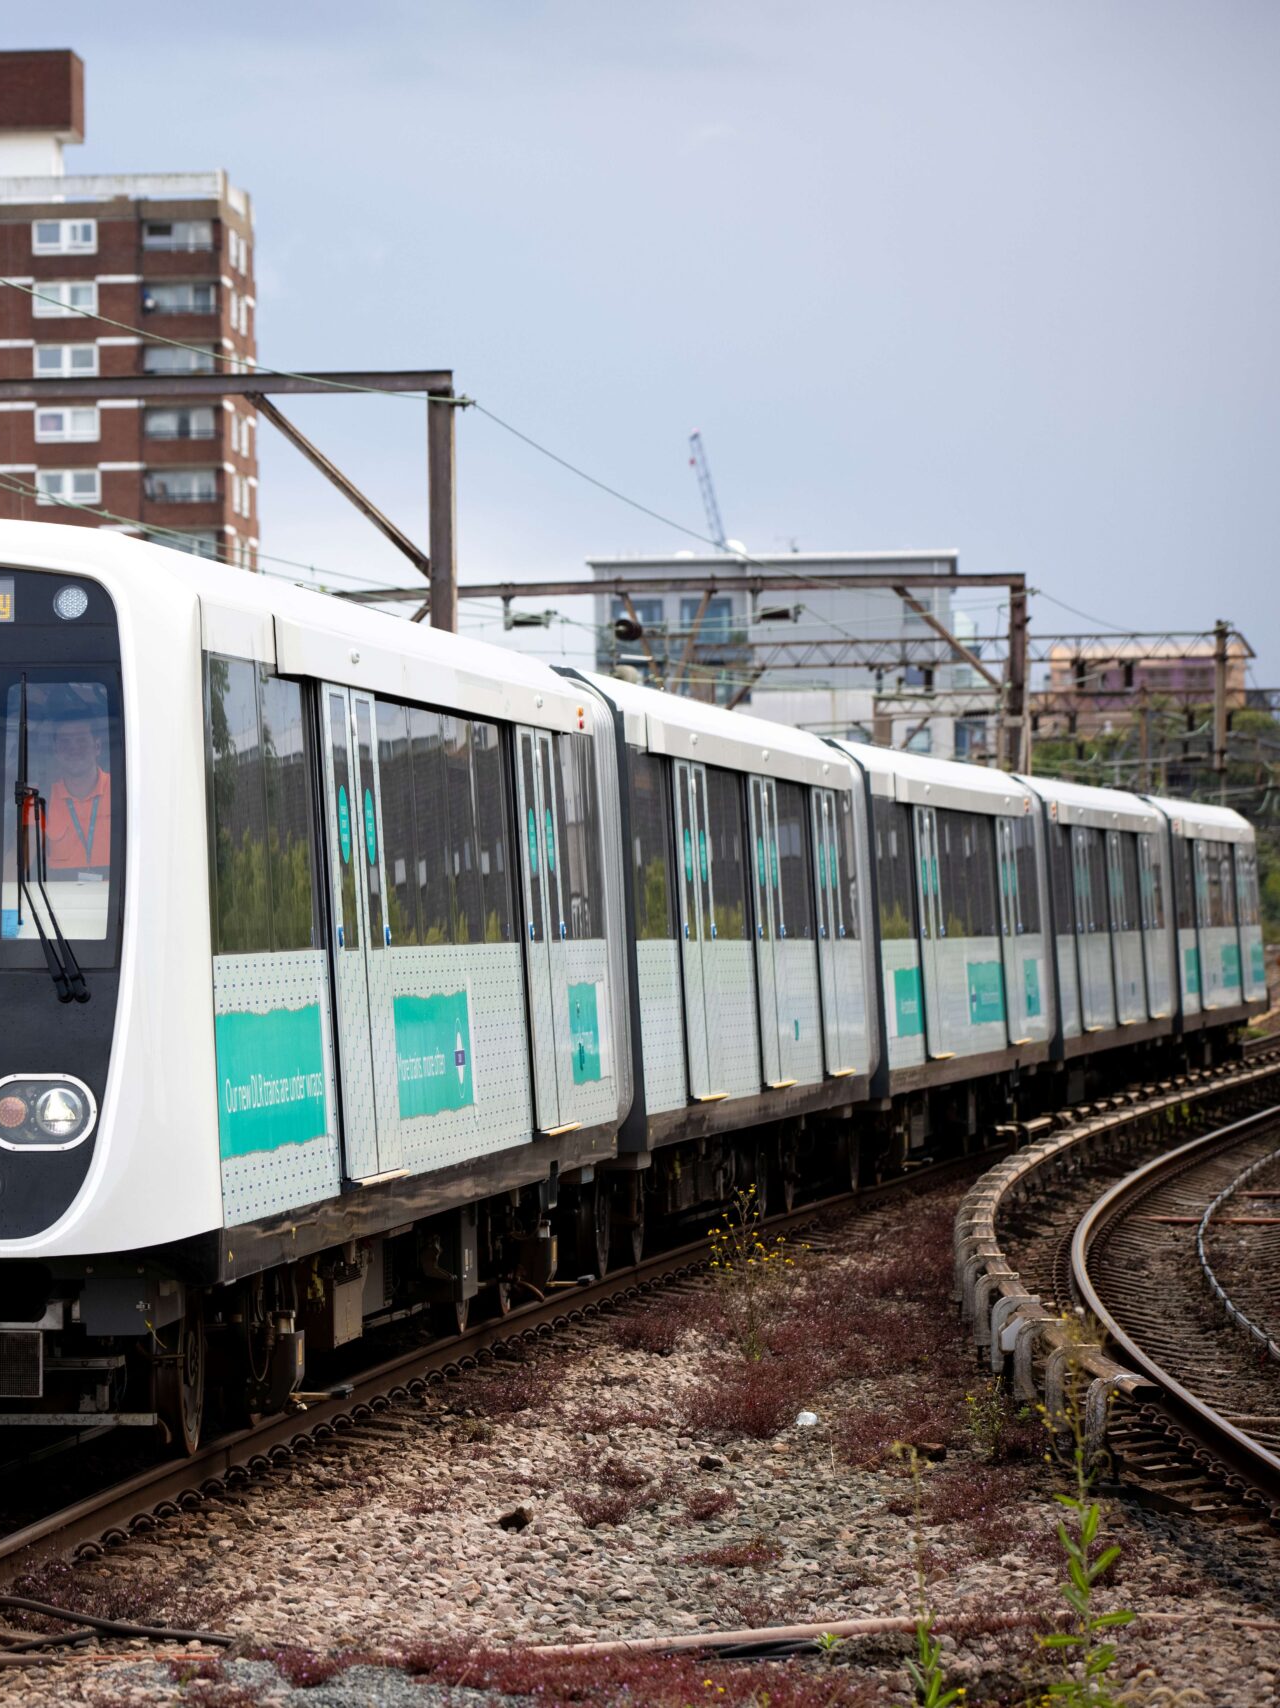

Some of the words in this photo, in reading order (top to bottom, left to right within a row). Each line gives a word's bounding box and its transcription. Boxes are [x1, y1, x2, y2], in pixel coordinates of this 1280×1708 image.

[226, 1078, 238, 1113] Our
[238, 1083, 251, 1111] new
[251, 1073, 264, 1109] DLR
[264, 1073, 279, 1106] trains
[280, 1077, 289, 1103] are
[289, 1066, 305, 1101] under
[306, 1071, 323, 1105] wraps
